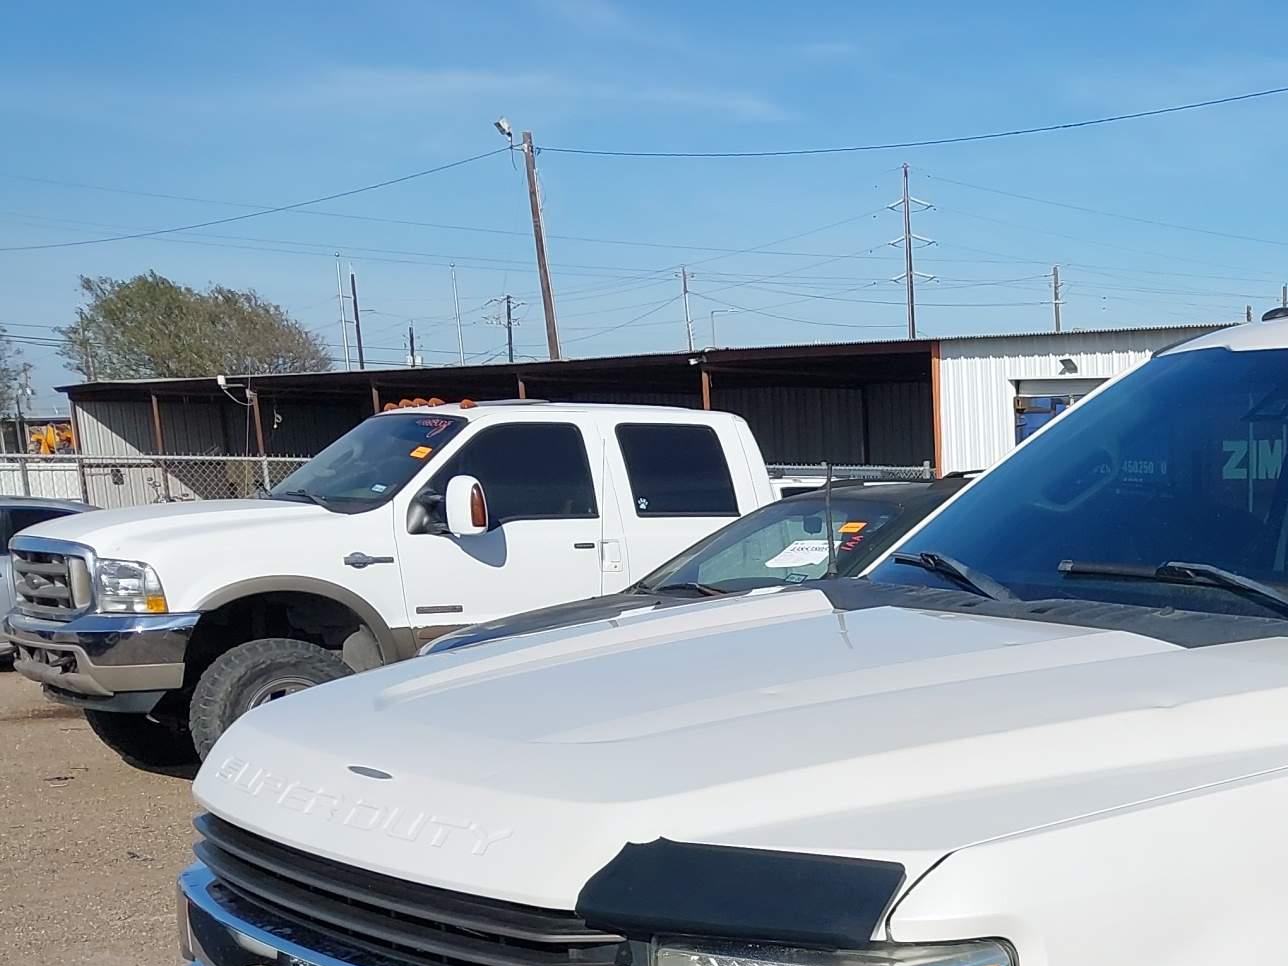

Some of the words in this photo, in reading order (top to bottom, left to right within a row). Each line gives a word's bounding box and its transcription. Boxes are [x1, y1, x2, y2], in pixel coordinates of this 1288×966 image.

[1222, 439, 1283, 480] ZIM
[214, 755, 340, 823] SUPER
[343, 798, 515, 857] DUTY
